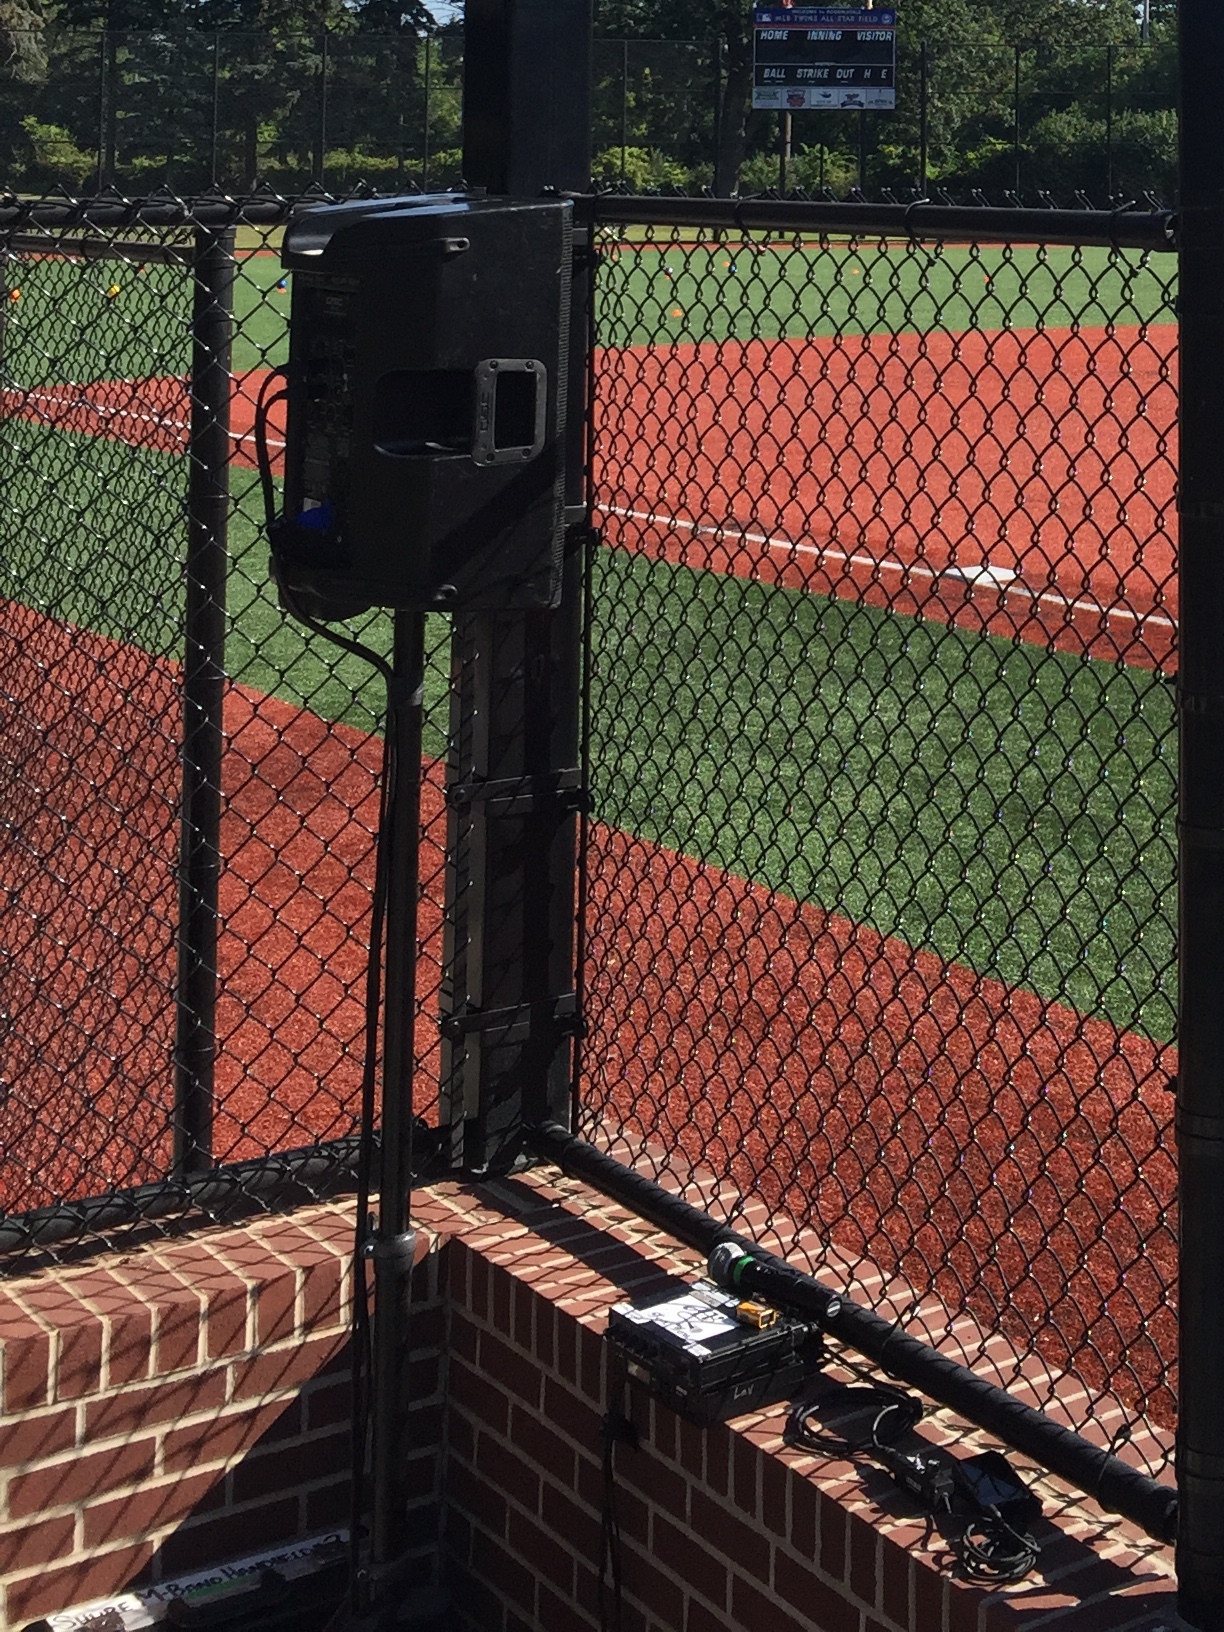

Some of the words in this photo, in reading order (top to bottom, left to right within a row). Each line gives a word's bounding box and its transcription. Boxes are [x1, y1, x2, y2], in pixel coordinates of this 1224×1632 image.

[820, 14, 834, 22] ALL
[837, 14, 855, 22] STAR
[760, 30, 789, 40] HOME
[807, 30, 842, 40] INNING
[856, 31, 893, 41] VISITOR
[763, 68, 786, 78] BALL
[796, 68, 829, 79] STRIKE
[836, 68, 855, 79] OUT
[864, 69, 871, 79] H
[881, 69, 887, 79] E
